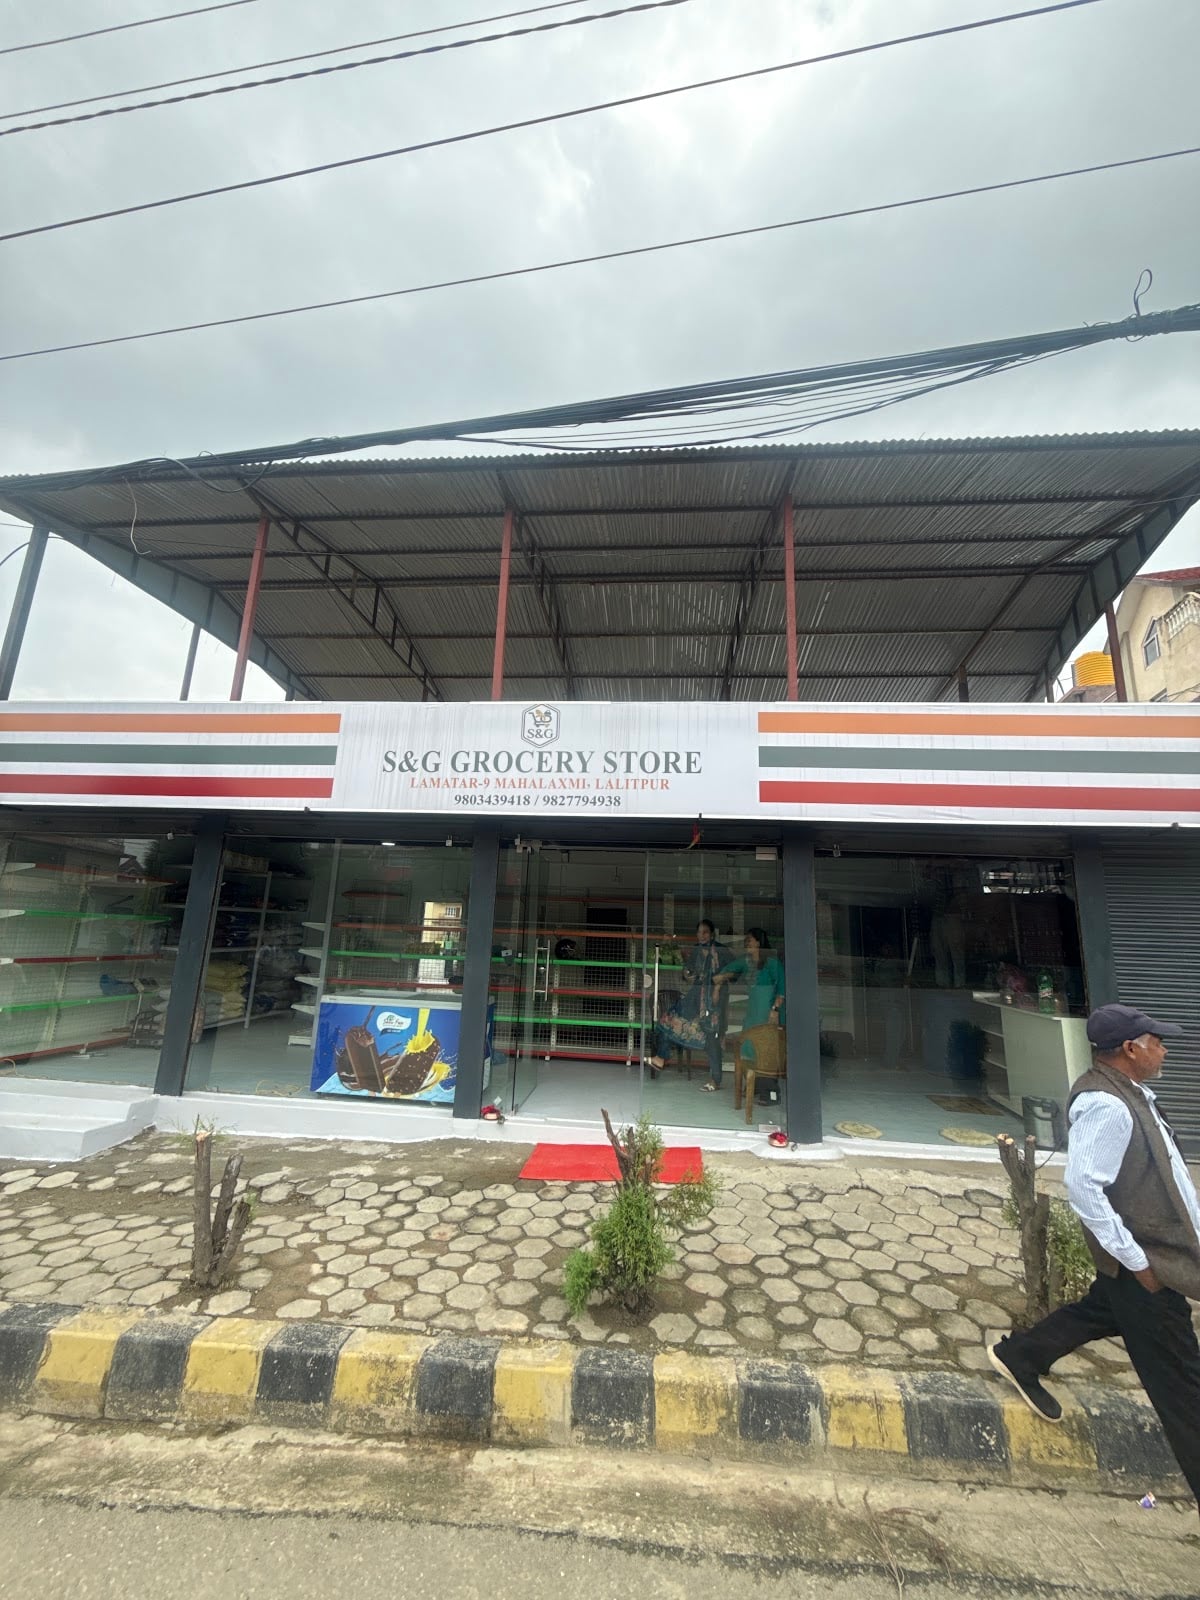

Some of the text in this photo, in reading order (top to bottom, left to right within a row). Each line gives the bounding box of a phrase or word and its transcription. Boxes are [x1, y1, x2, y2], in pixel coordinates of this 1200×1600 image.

[527, 728, 553, 739] S&G
[382, 750, 702, 774] S&G GROCERY STORE
[410, 777, 490, 789] LAMATAR-9
[595, 778, 670, 790] LALITPUR
[454, 794, 531, 806] 9803439418
[543, 795, 621, 807] 9827794938
